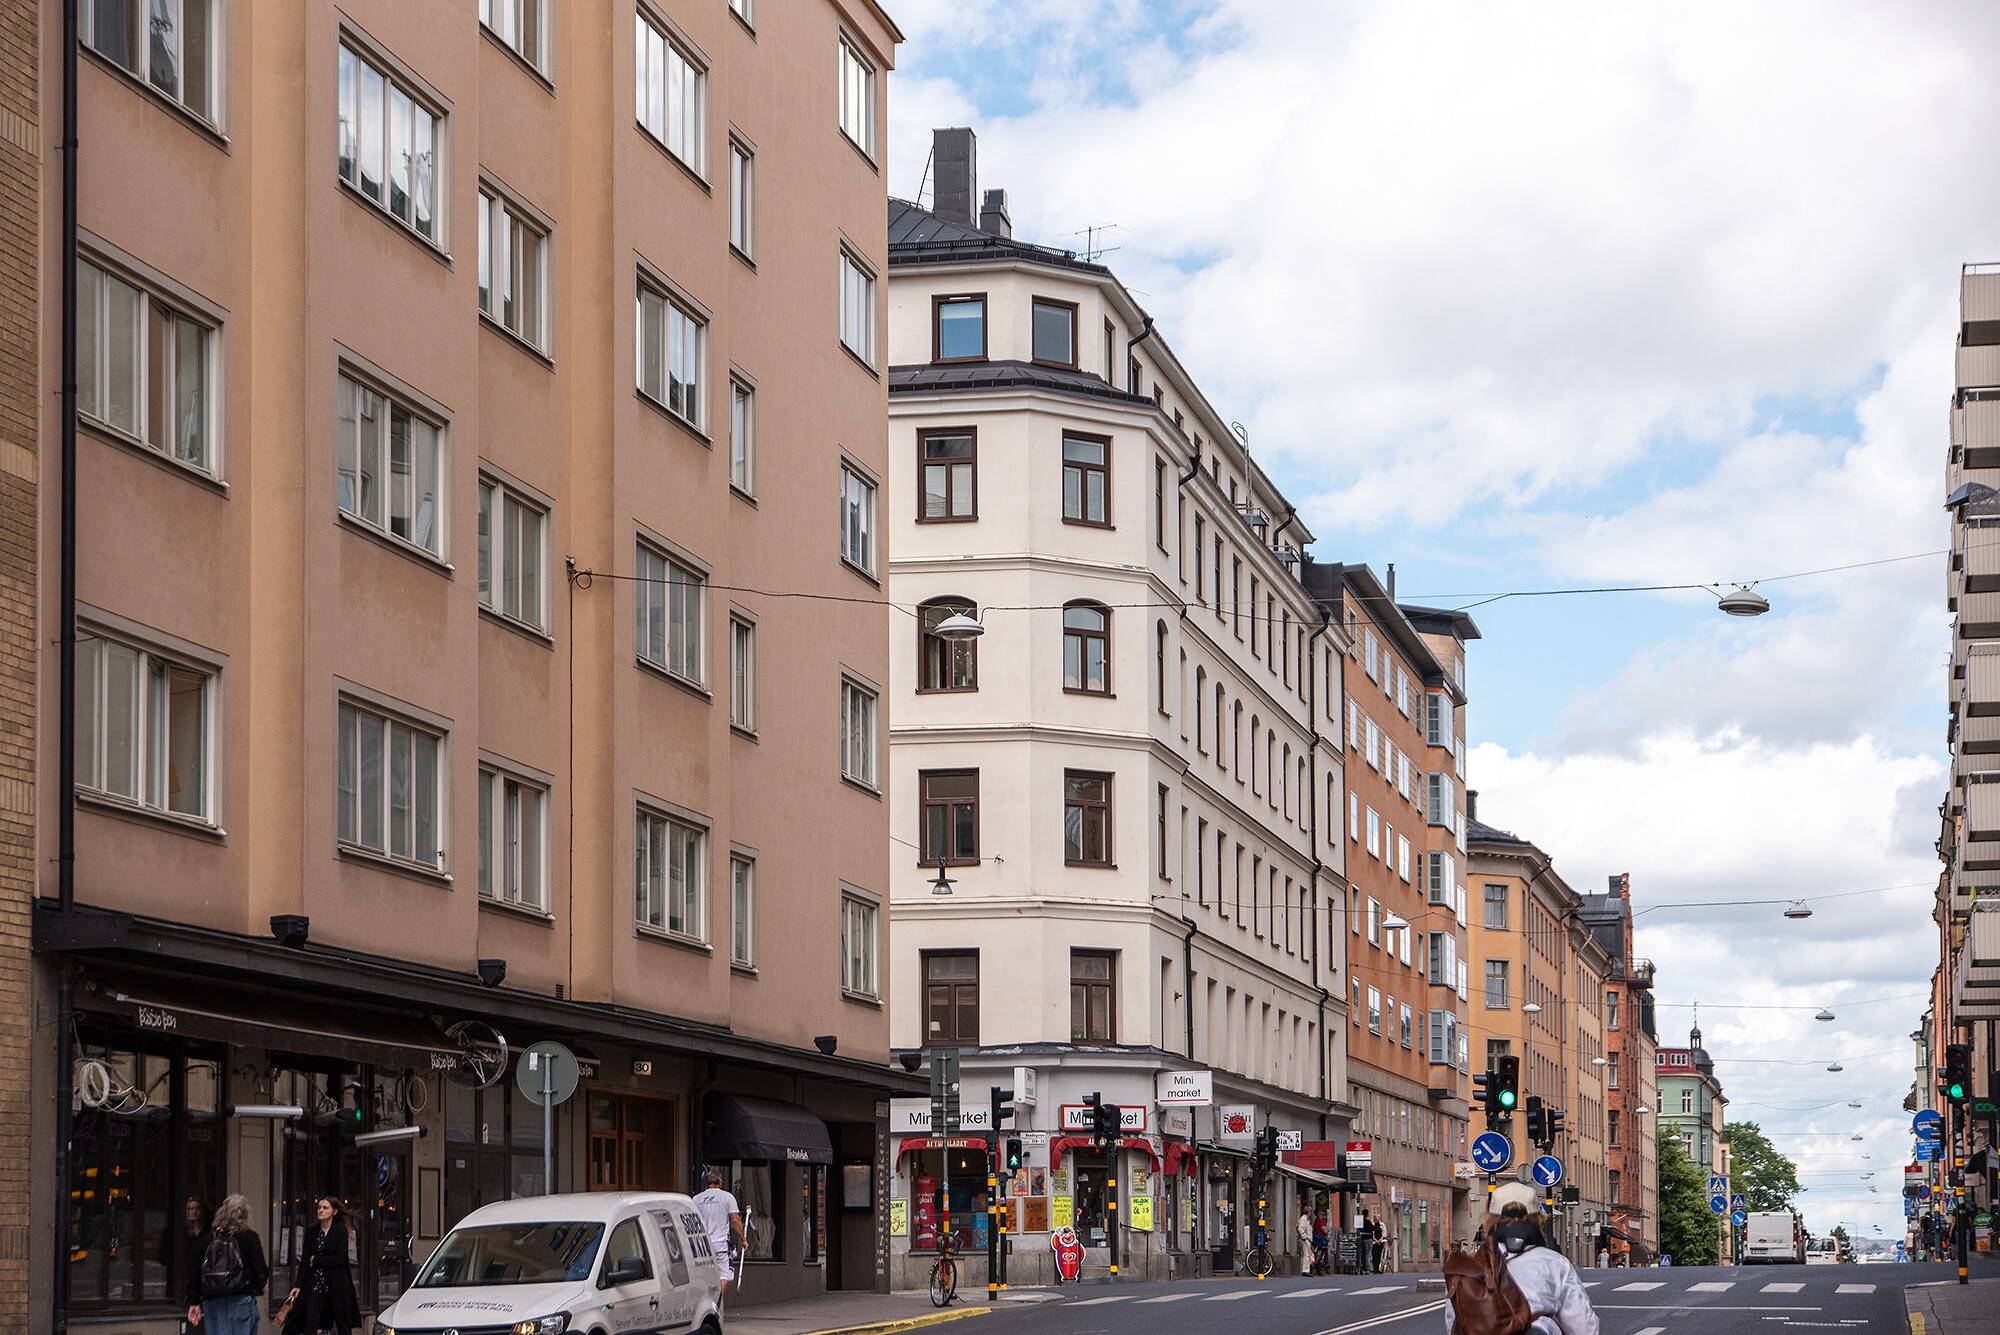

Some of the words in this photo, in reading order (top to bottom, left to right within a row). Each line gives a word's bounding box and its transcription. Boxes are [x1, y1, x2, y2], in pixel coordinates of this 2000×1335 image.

[635, 1063, 649, 1072] 30
[1174, 1075, 1194, 1085] Mini
[1167, 1089, 1201, 1098] market
[909, 1112, 933, 1125] Min
[1223, 1125, 1251, 1134] KG
